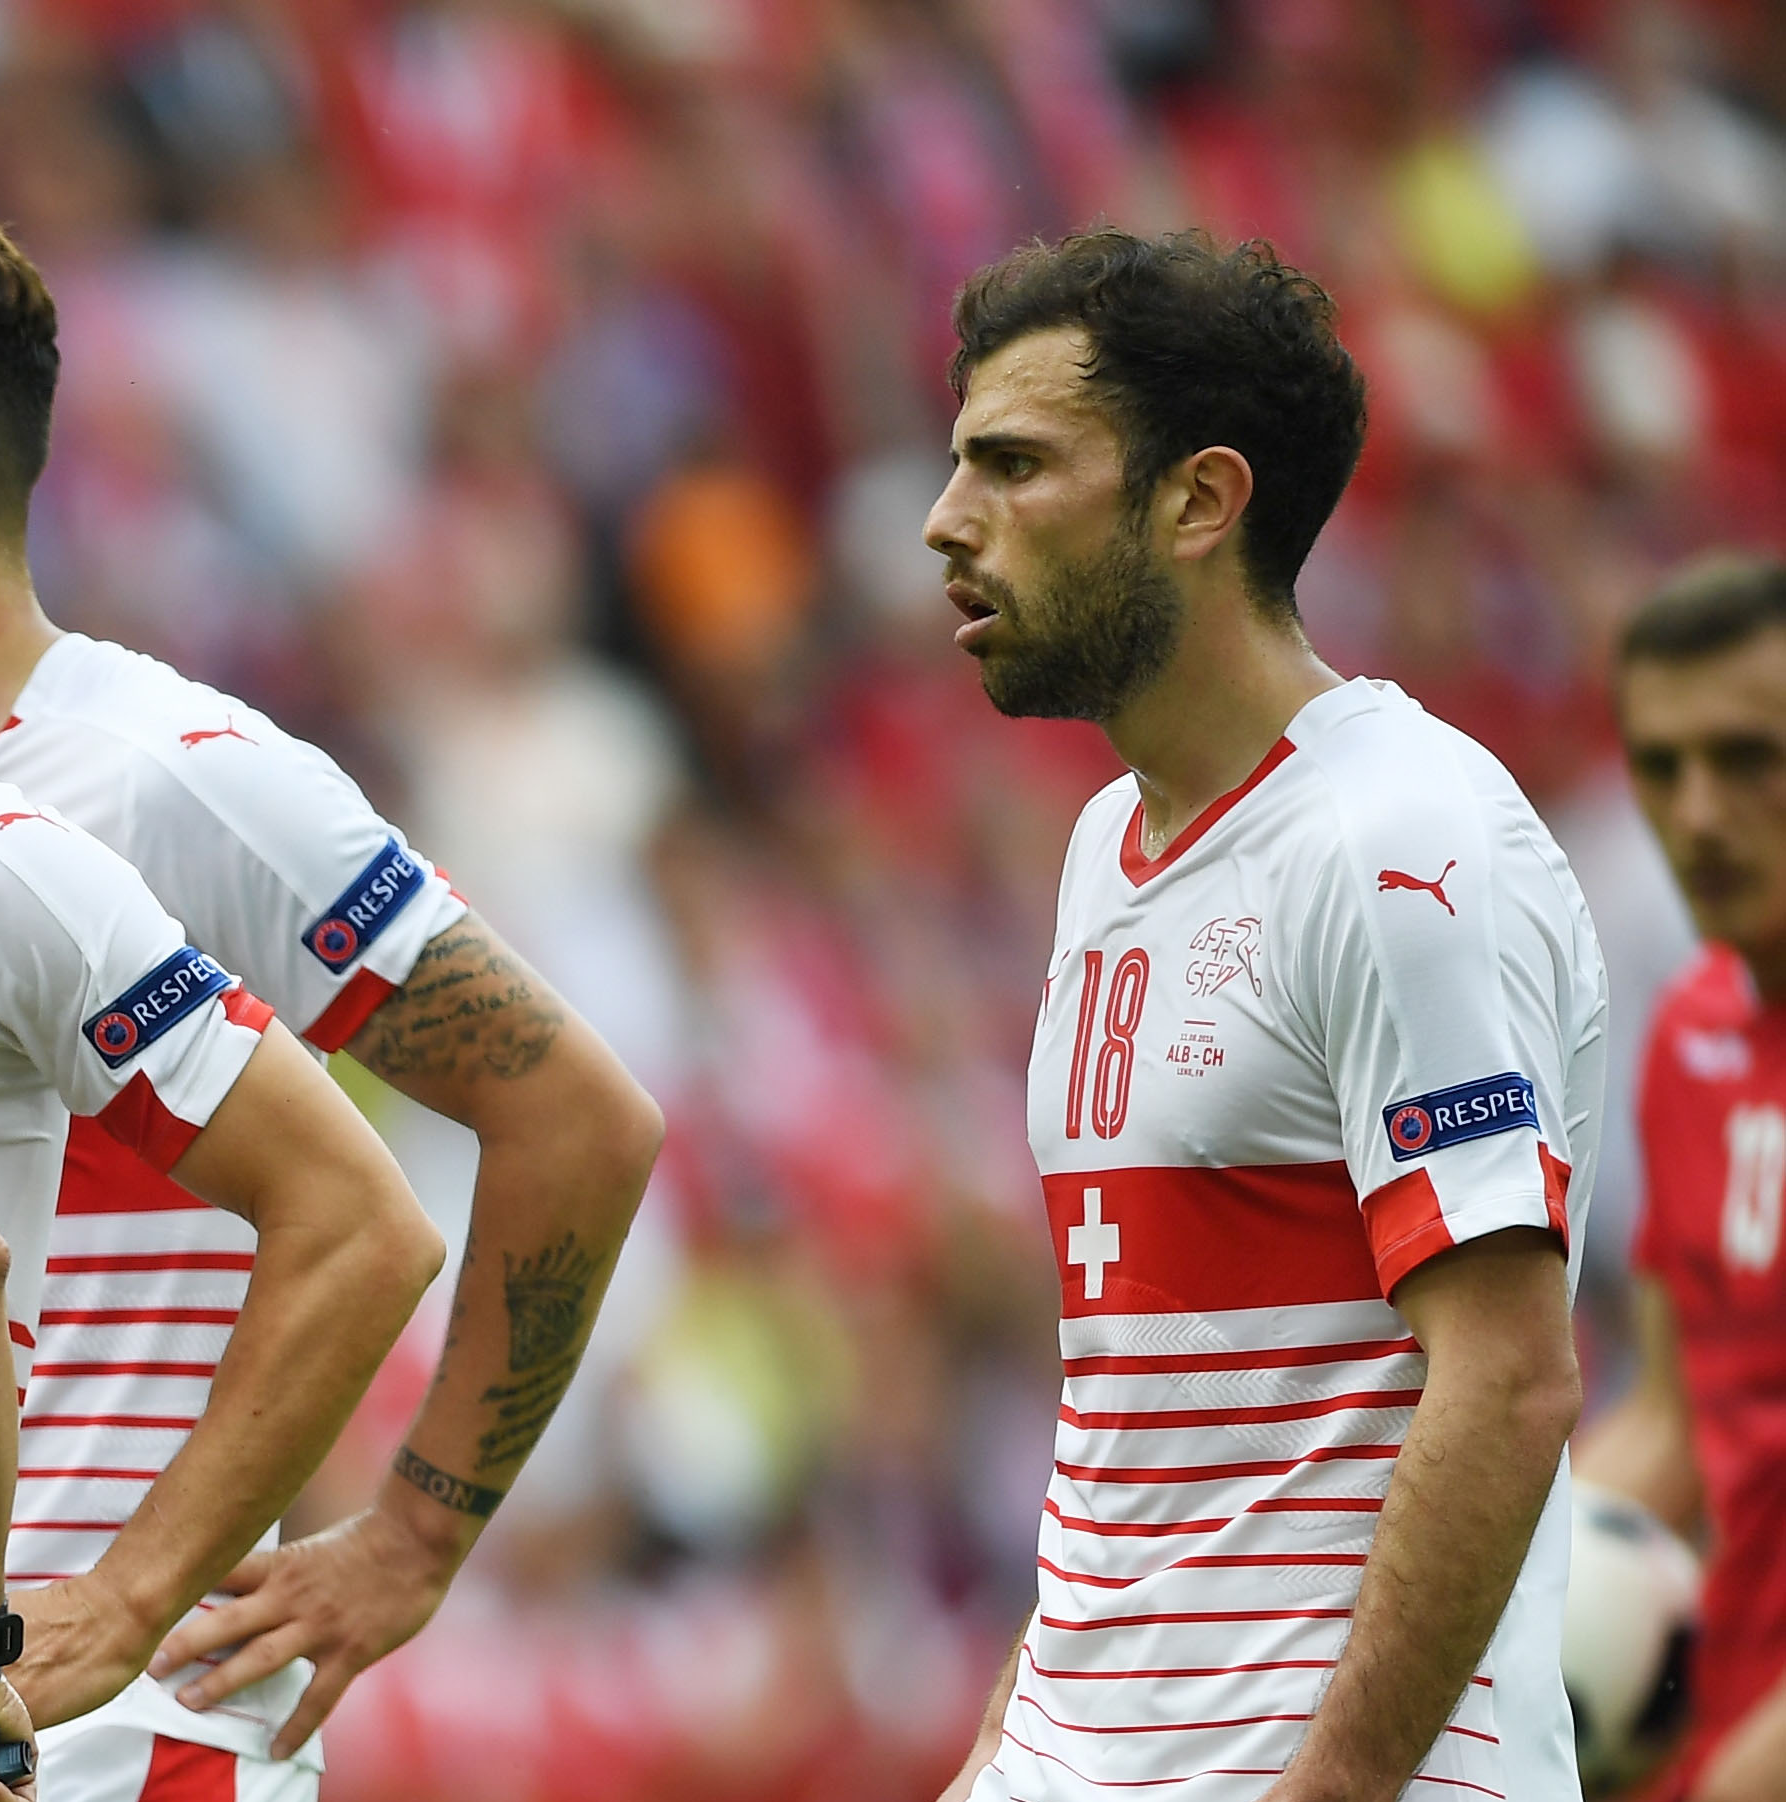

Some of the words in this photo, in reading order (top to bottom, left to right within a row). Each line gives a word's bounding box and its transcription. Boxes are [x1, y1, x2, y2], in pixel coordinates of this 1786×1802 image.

[347, 854, 414, 929] RESPE
[133, 957, 216, 1027] RESPEC
[1066, 948, 1150, 1140] 18
[1166, 1045, 1190, 1063] ALB
[1202, 1048, 1224, 1066] CH
[1435, 1088, 1535, 1131] RESPEC
